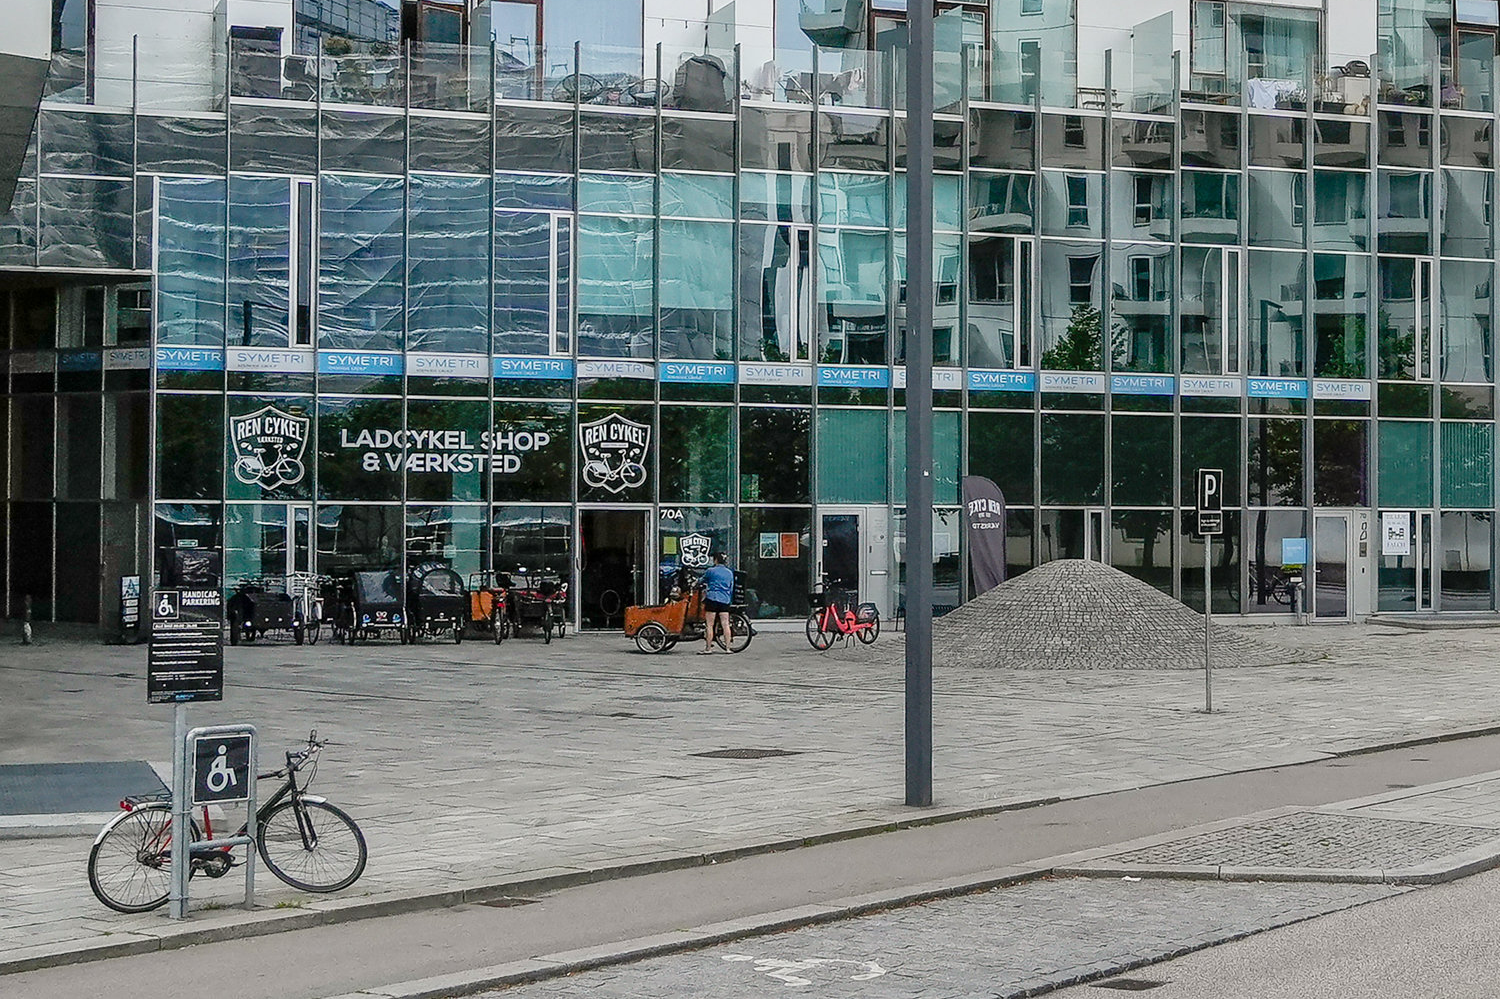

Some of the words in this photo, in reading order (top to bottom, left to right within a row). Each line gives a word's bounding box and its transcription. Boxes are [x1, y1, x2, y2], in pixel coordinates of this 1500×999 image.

[156, 350, 222, 361] SYMETR
[237, 352, 304, 363] SYMETRI
[327, 354, 393, 367] SYMETRI
[415, 357, 480, 369] SYMETRI
[501, 360, 564, 371] SYMETRI
[585, 362, 646, 373] SYMETRI
[666, 364, 726, 376] SYMETRI
[745, 367, 804, 377] SYMETRI
[822, 369, 880, 380] SYMETRI
[972, 372, 1027, 383] SYMETRI
[1044, 375, 1097, 385] SYMETRI
[1113, 377, 1166, 387] SYMETRI
[1183, 379, 1233, 389] SYMETRI
[1250, 381, 1300, 391] SYMETRI
[1315, 383, 1364, 393] SYMETRI
[237, 418, 261, 441] REN
[264, 416, 303, 441] CYKEL
[341, 428, 474, 449] LADCYKEL
[480, 431, 550, 451] SHOP
[585, 424, 607, 446] REN
[610, 423, 645, 447] CYKEL
[362, 452, 381, 471] &
[385, 452, 521, 473] VÆRKSTED
[1205, 474, 1217, 508] P
[660, 509, 684, 519] 70A
